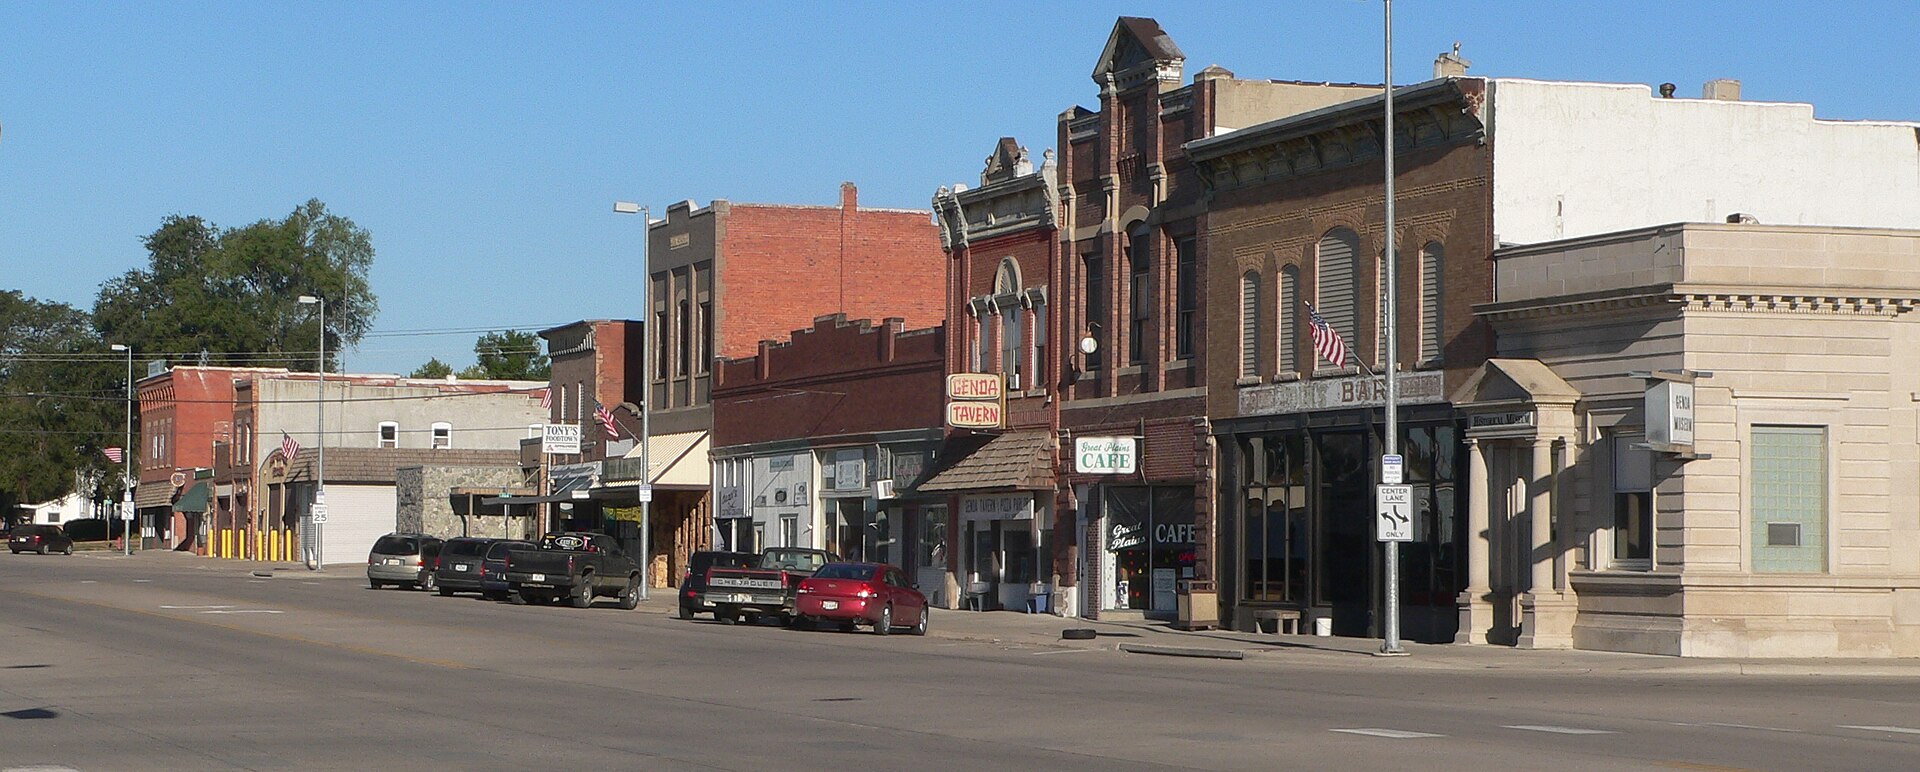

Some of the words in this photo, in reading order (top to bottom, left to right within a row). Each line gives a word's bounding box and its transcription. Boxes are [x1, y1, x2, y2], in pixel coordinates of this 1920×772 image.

[953, 406, 998, 422] TAVERN
[545, 425, 578, 436] TONY'S
[1081, 441, 1102, 452] Great
[1104, 441, 1130, 452] Plains
[1081, 452, 1131, 469] CAFE
[1112, 521, 1142, 538] Great
[1155, 523, 1196, 543] CAFE
[1111, 535, 1146, 550] Plains
[717, 578, 775, 587] CHEVROLET
